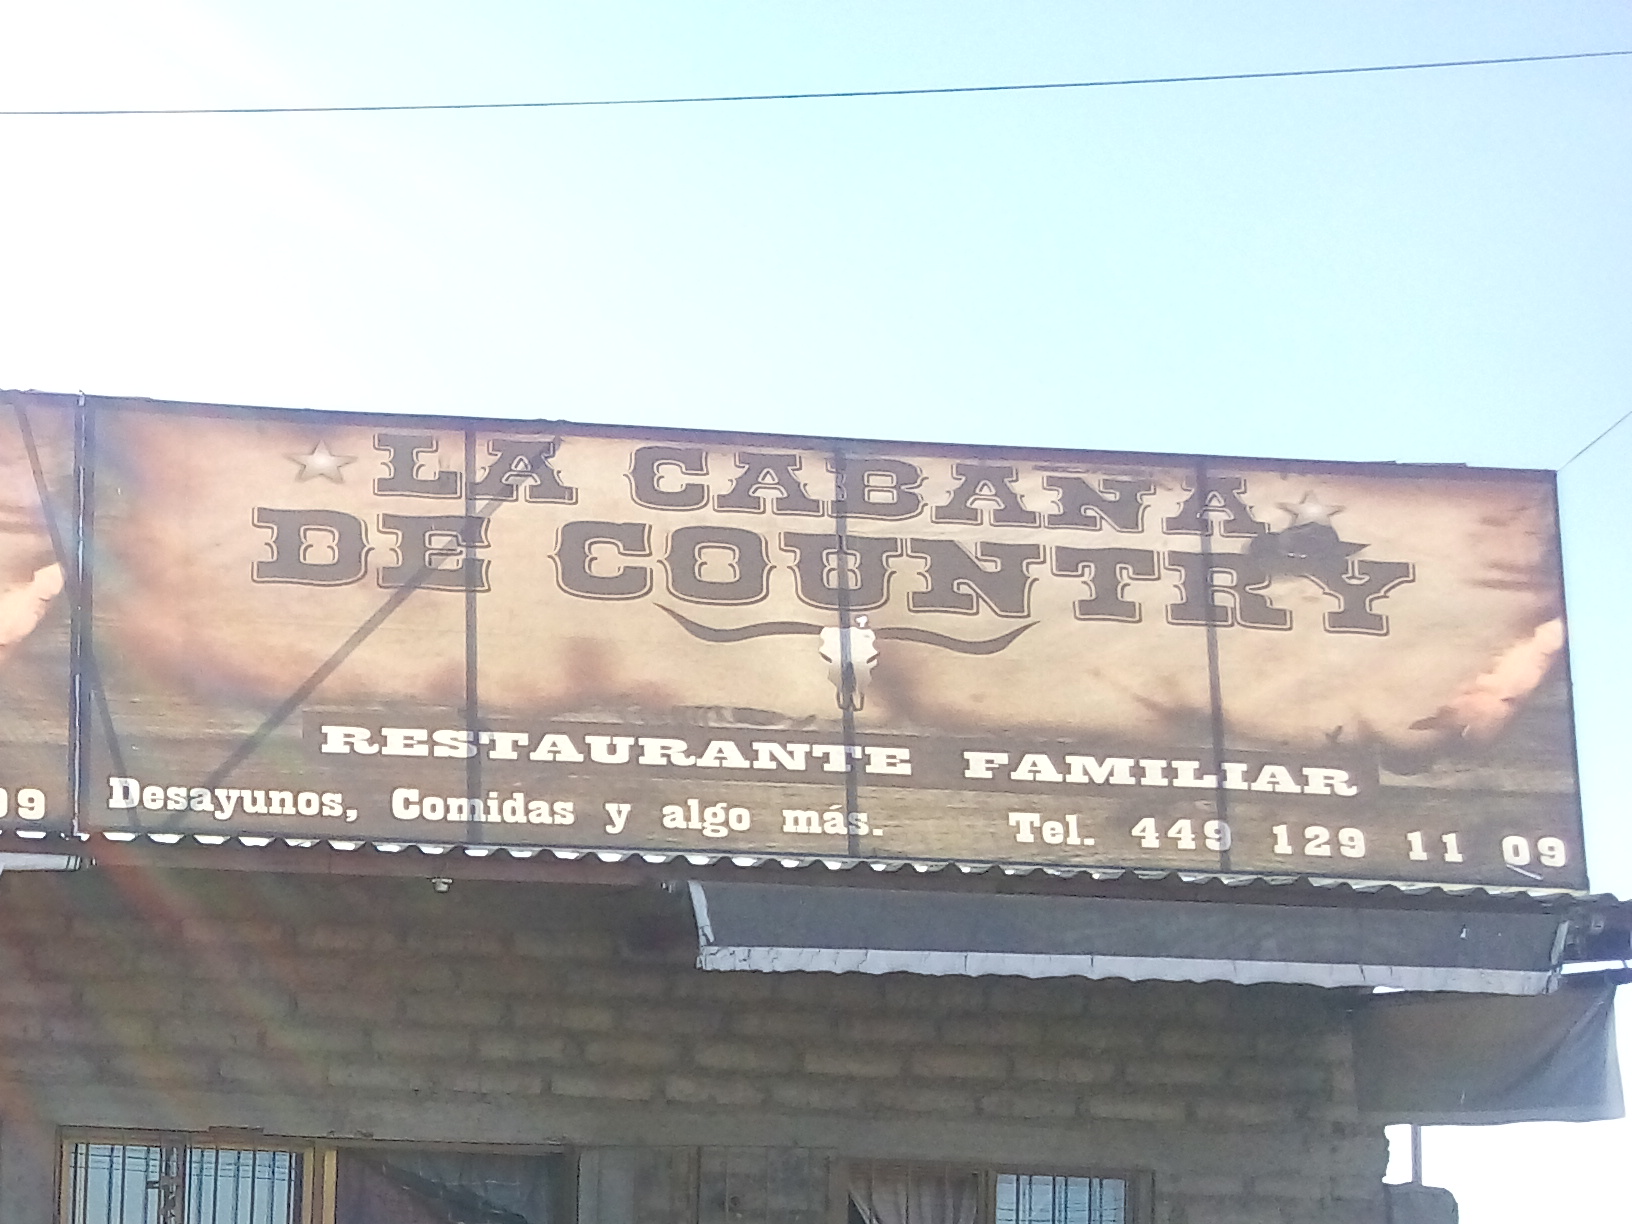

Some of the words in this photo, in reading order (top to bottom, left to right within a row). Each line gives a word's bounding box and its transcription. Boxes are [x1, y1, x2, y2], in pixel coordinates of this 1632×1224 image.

[372, 432, 578, 505] LA
[251, 505, 491, 593] DE
[547, 520, 1416, 637] COUNTRY
[320, 724, 913, 776] RESTAURANTE
[963, 750, 1360, 798] FAMILIAR
[107, 775, 360, 824] Desayunos,
[390, 787, 576, 827] Comidas
[604, 800, 632, 834] y
[661, 797, 753, 839] algo
[781, 803, 886, 838] más.
[1009, 811, 1098, 847] Tel.
[1130, 816, 1233, 852] 449
[1271, 822, 1368, 860] 129
[1405, 830, 1466, 864] 11
[1501, 834, 1569, 870] 09
